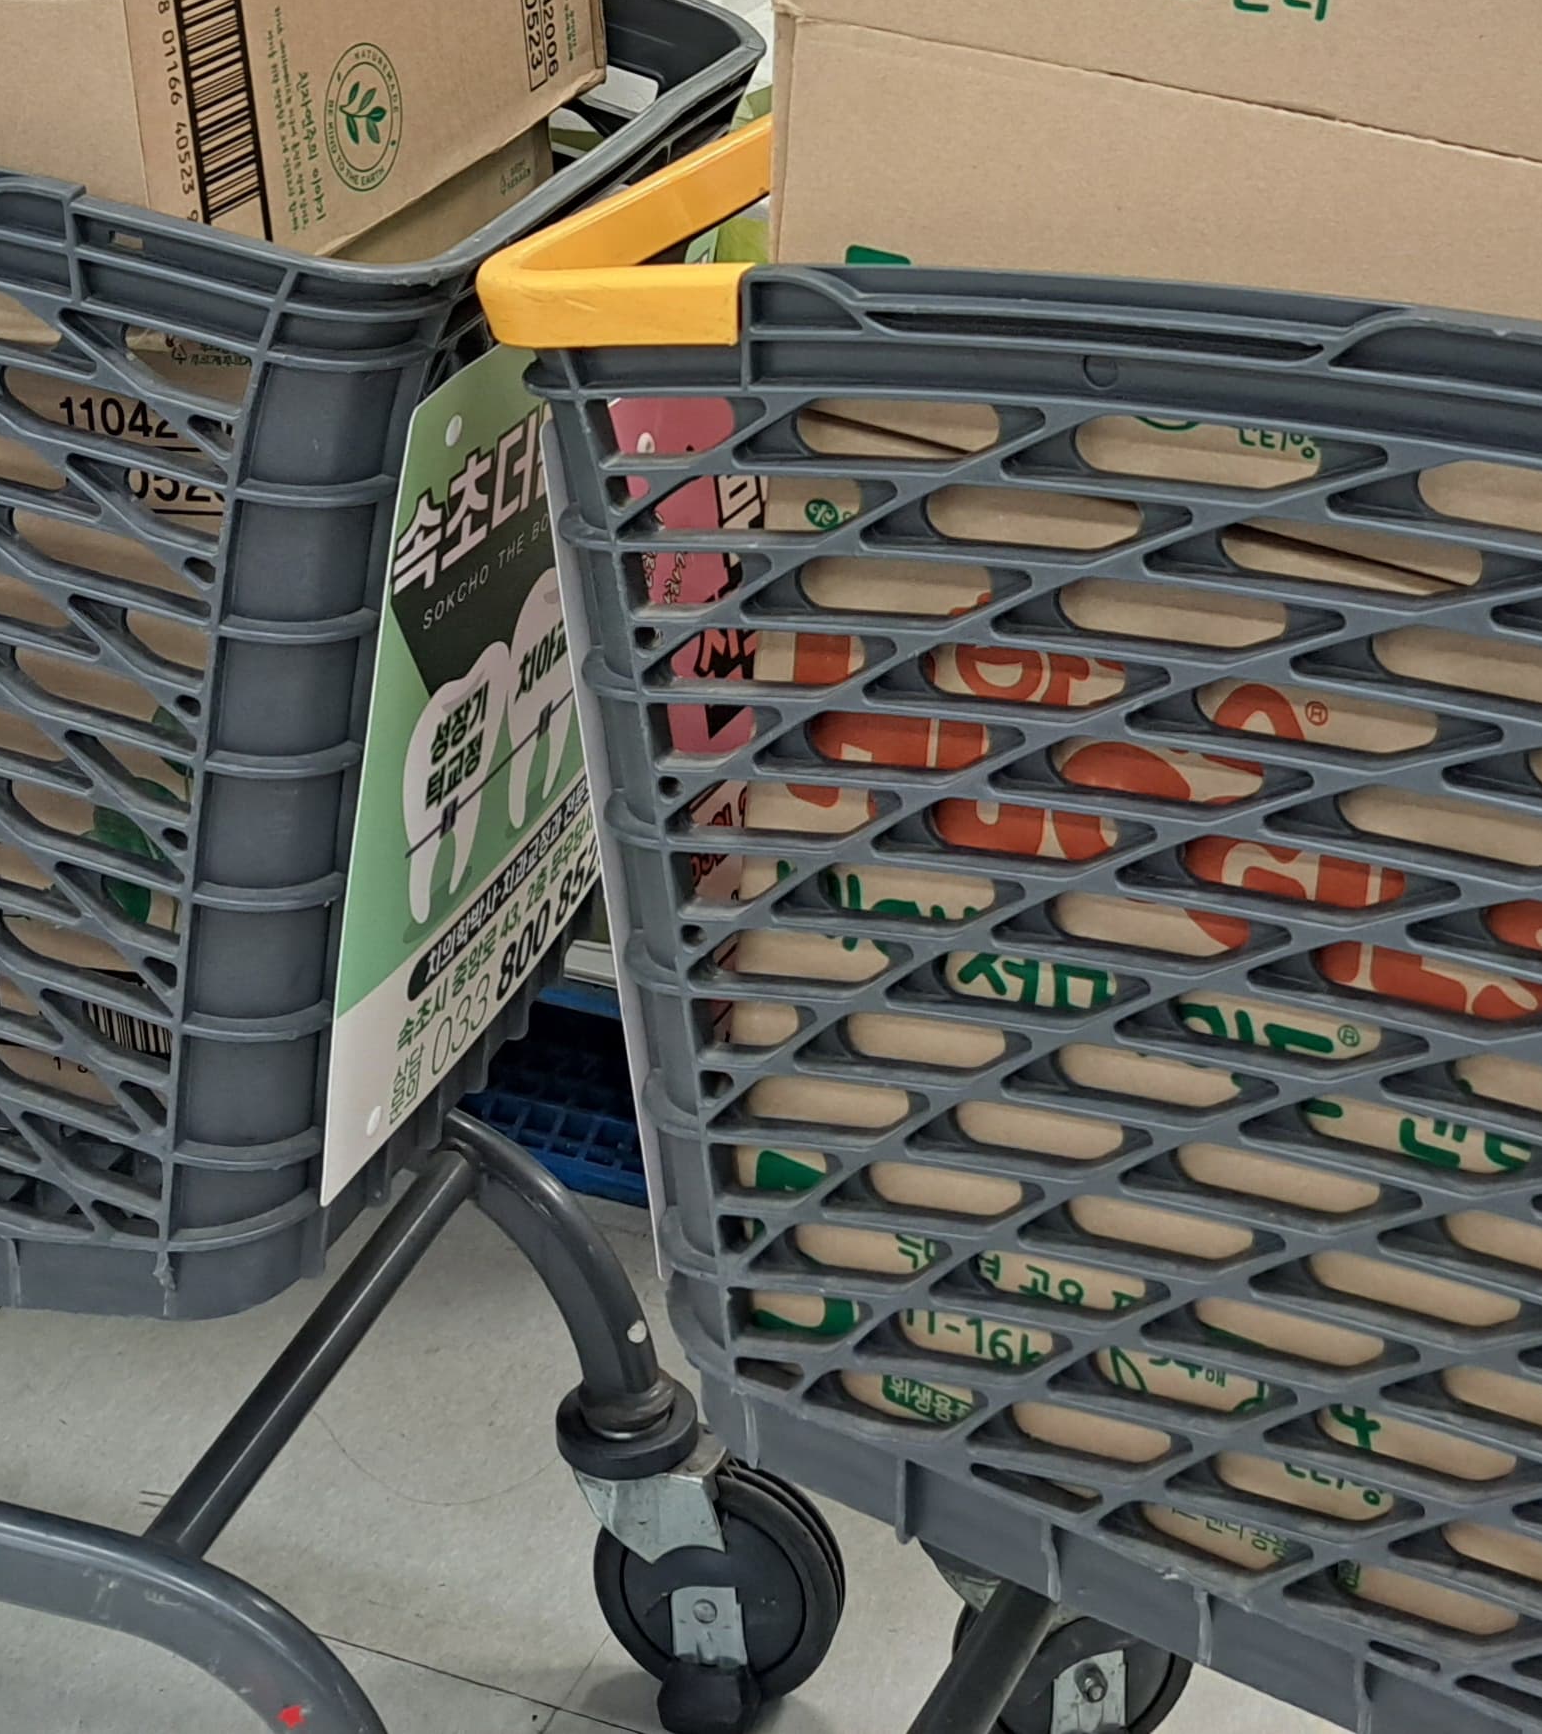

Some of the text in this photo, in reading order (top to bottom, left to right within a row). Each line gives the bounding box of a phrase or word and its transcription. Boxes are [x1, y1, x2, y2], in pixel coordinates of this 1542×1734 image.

[160, 27, 183, 107] 01166
[173, 120, 195, 196] 40523
[422, 532, 526, 630] SOKCHO THE
[425, 733, 485, 811] 턱교정
[430, 680, 490, 766] 성장기
[396, 869, 546, 1052] 속초시 중앙로 43, 2층
[431, 899, 551, 1076] 033 800
[389, 1071, 420, 1125] 문의
